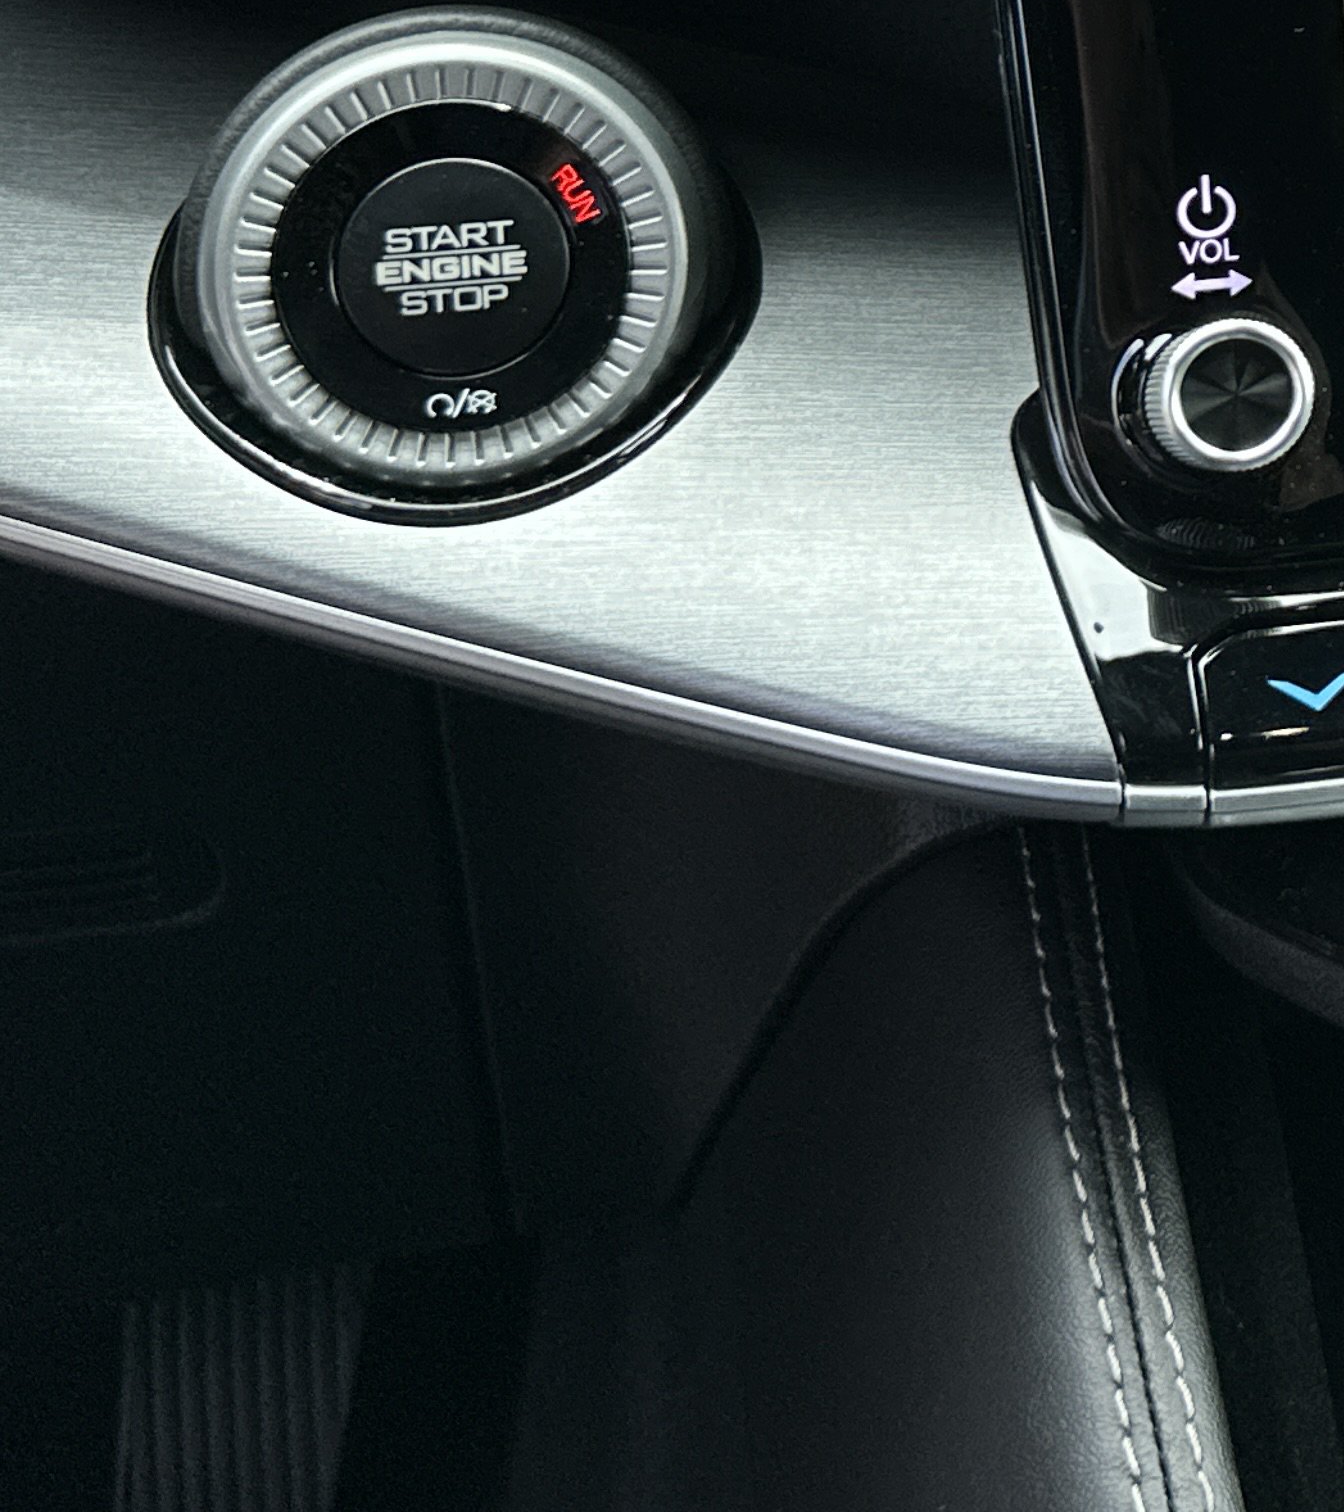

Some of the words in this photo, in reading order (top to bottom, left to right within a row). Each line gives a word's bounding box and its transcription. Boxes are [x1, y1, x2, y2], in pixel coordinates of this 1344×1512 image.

[551, 164, 600, 224] RUN
[384, 220, 514, 251] START
[1178, 238, 1240, 265] VOL
[376, 250, 528, 286] ENGINE
[401, 285, 509, 316] STOP
